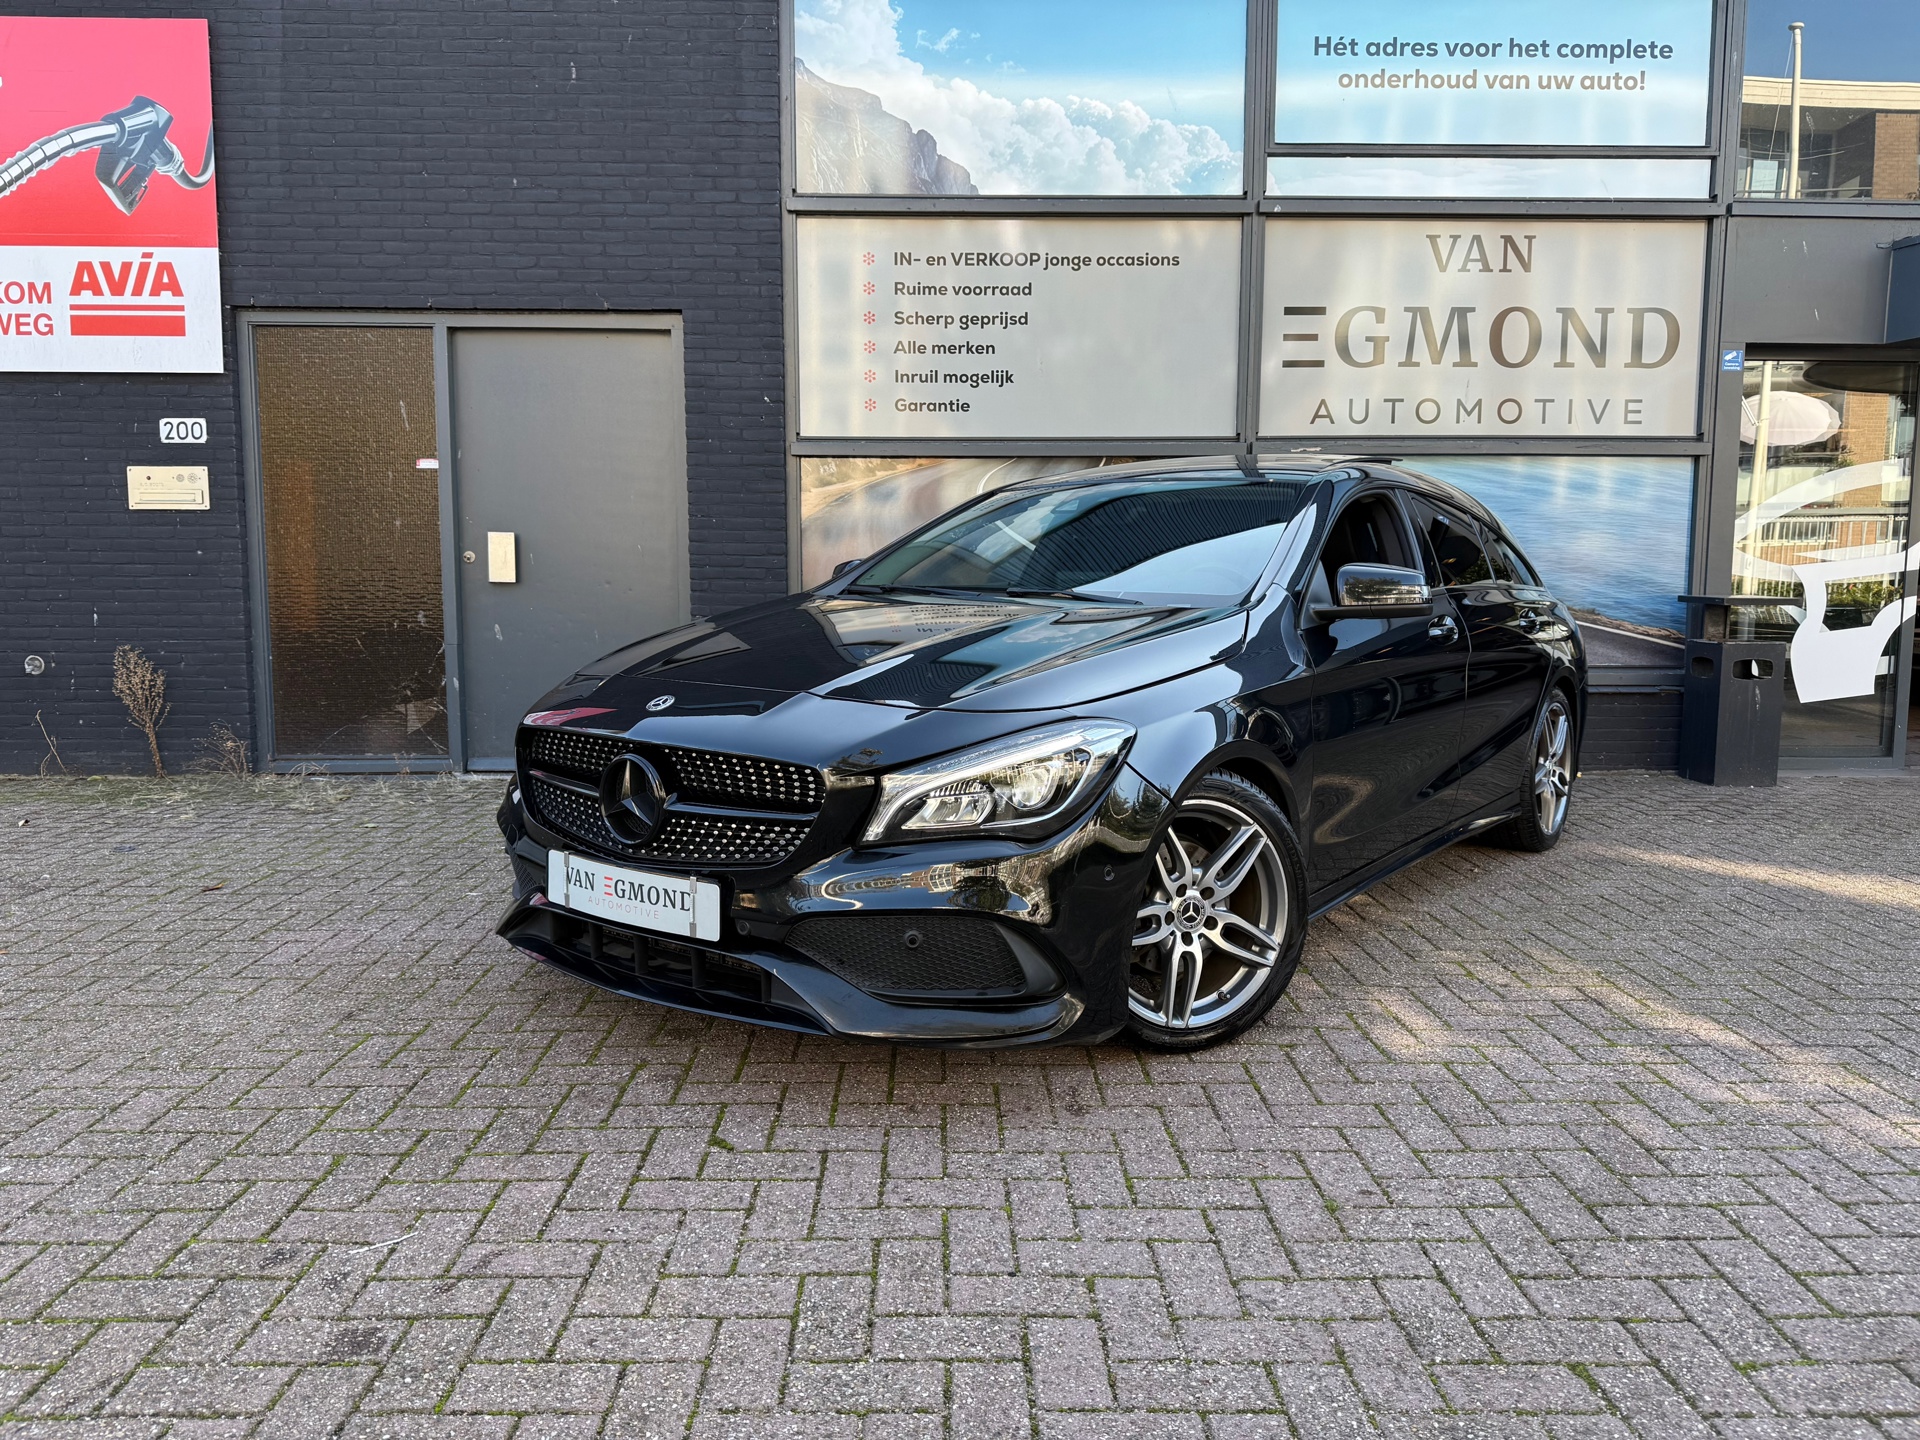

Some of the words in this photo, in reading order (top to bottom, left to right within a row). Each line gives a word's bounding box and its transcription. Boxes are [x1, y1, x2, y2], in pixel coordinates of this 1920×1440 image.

[1313, 35, 1359, 57] Hét
[1365, 36, 1439, 58] adres
[1444, 42, 1504, 58] voor
[1508, 37, 1551, 59] het
[1556, 38, 1674, 64] complete
[1337, 68, 1478, 90] onderhoud
[1484, 74, 1530, 90] van
[1537, 74, 1575, 90] uw
[1579, 70, 1646, 91] auto!
[893, 252, 921, 267] IN-
[925, 255, 947, 267] en
[950, 251, 1041, 267] VERKOOP
[1042, 251, 1093, 272] jonge
[1096, 251, 1180, 267] occasions
[1425, 234, 1537, 274] VAN
[0, 281, 52, 304] OM
[893, 281, 948, 297] Ruime
[952, 281, 1033, 297] voorraad
[893, 310, 955, 330] Scherp
[958, 310, 1029, 331] geprijsd
[893, 340, 928, 355] Alle
[931, 340, 996, 355] merken
[1281, 305, 1682, 370] EGMOND
[894, 369, 939, 384] Inruil
[943, 369, 1015, 389] mogelijk
[894, 397, 971, 413] Garantie
[1309, 397, 1644, 425] AUTOMOTIVE
[163, 420, 204, 441] 200
[566, 866, 596, 892] VAN
[604, 876, 691, 912] EGMOND
[588, 895, 660, 920] AUTOMOTIVE
